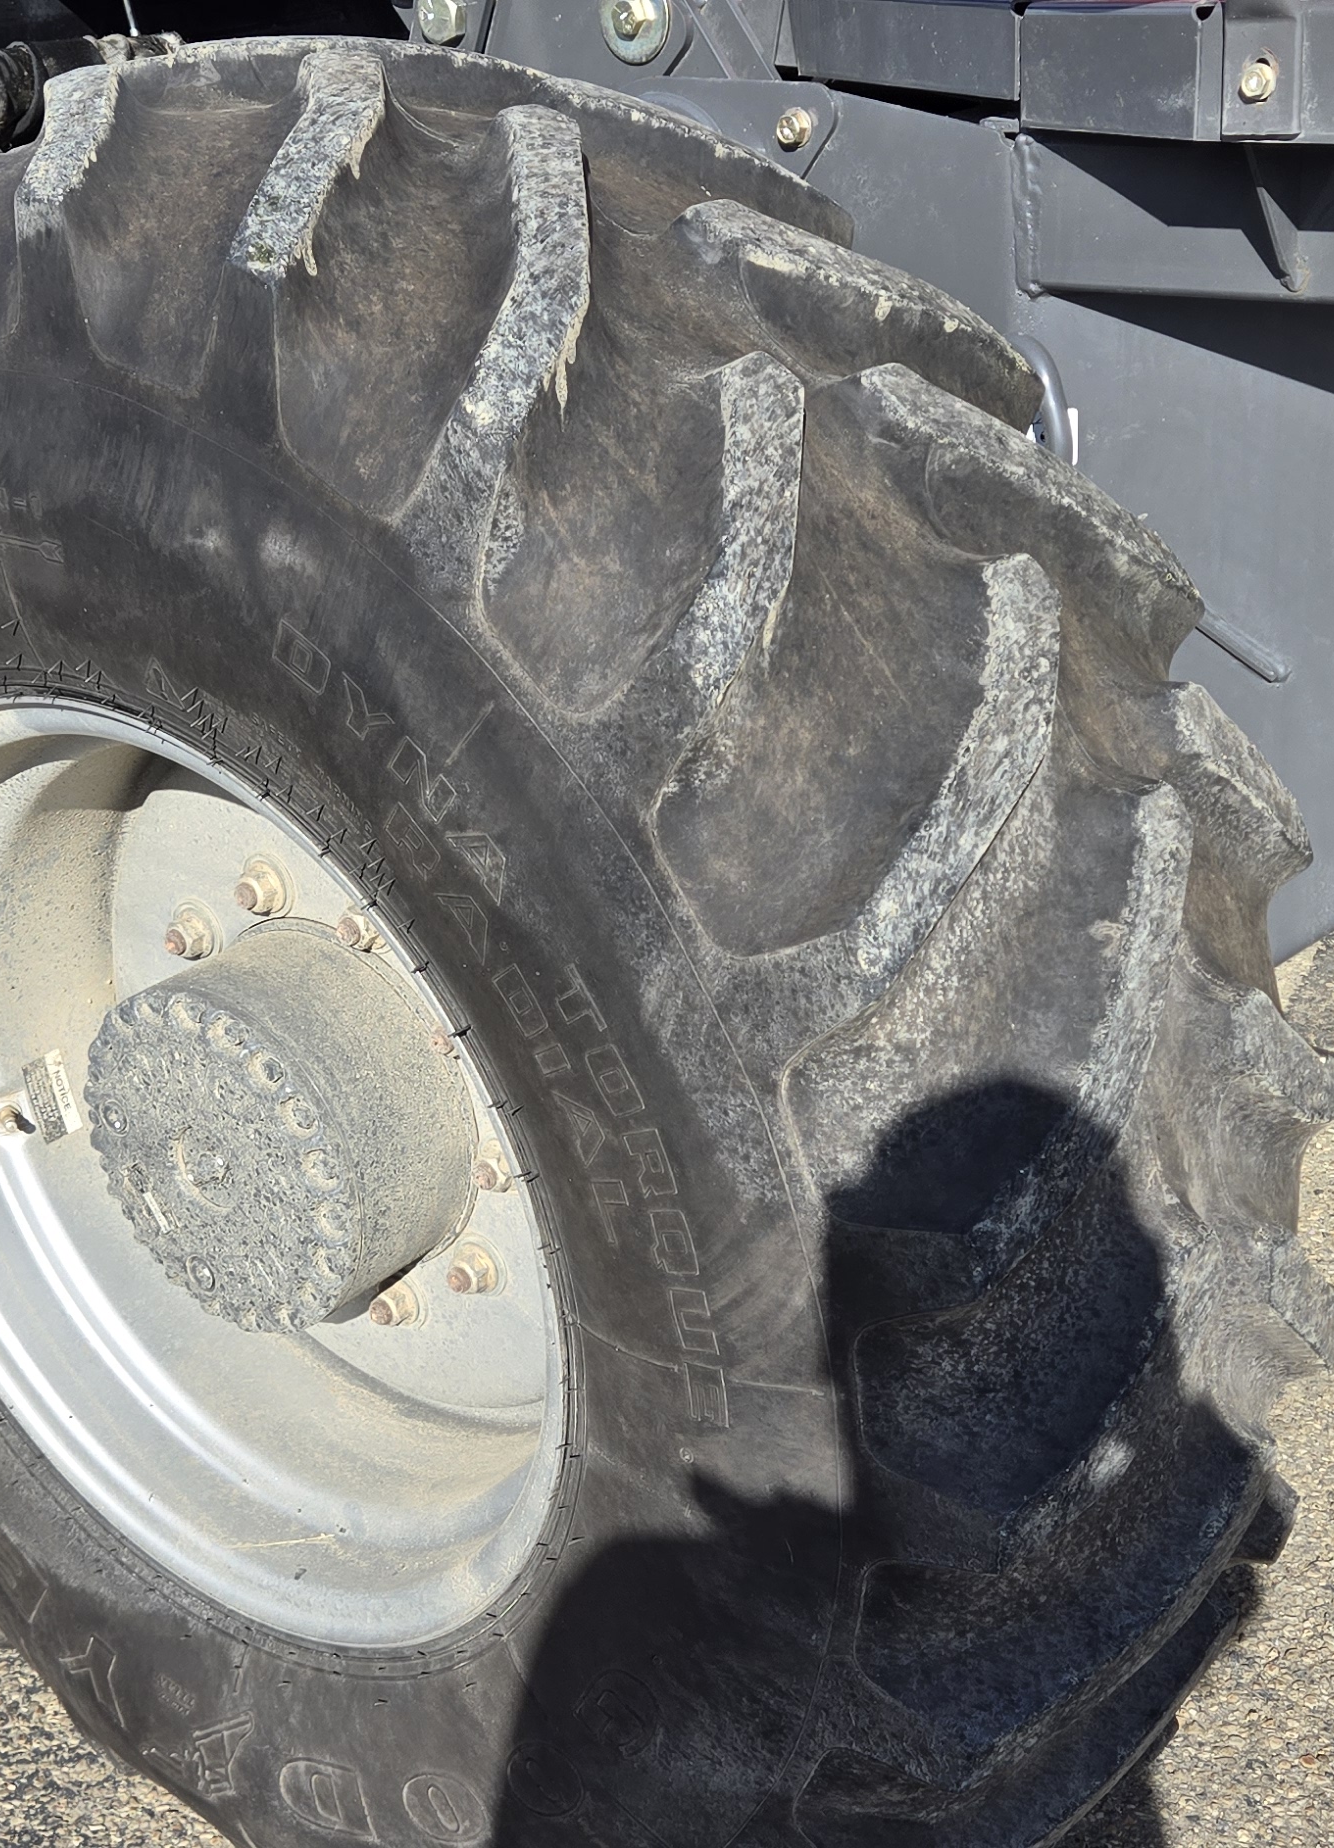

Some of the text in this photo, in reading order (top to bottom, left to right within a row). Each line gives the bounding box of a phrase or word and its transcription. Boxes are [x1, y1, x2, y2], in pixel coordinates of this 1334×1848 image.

[52, 1069, 73, 1111] NOTICE
[271, 618, 731, 1427] DYNA TORQUE
[385, 803, 633, 1245] RADIAL
